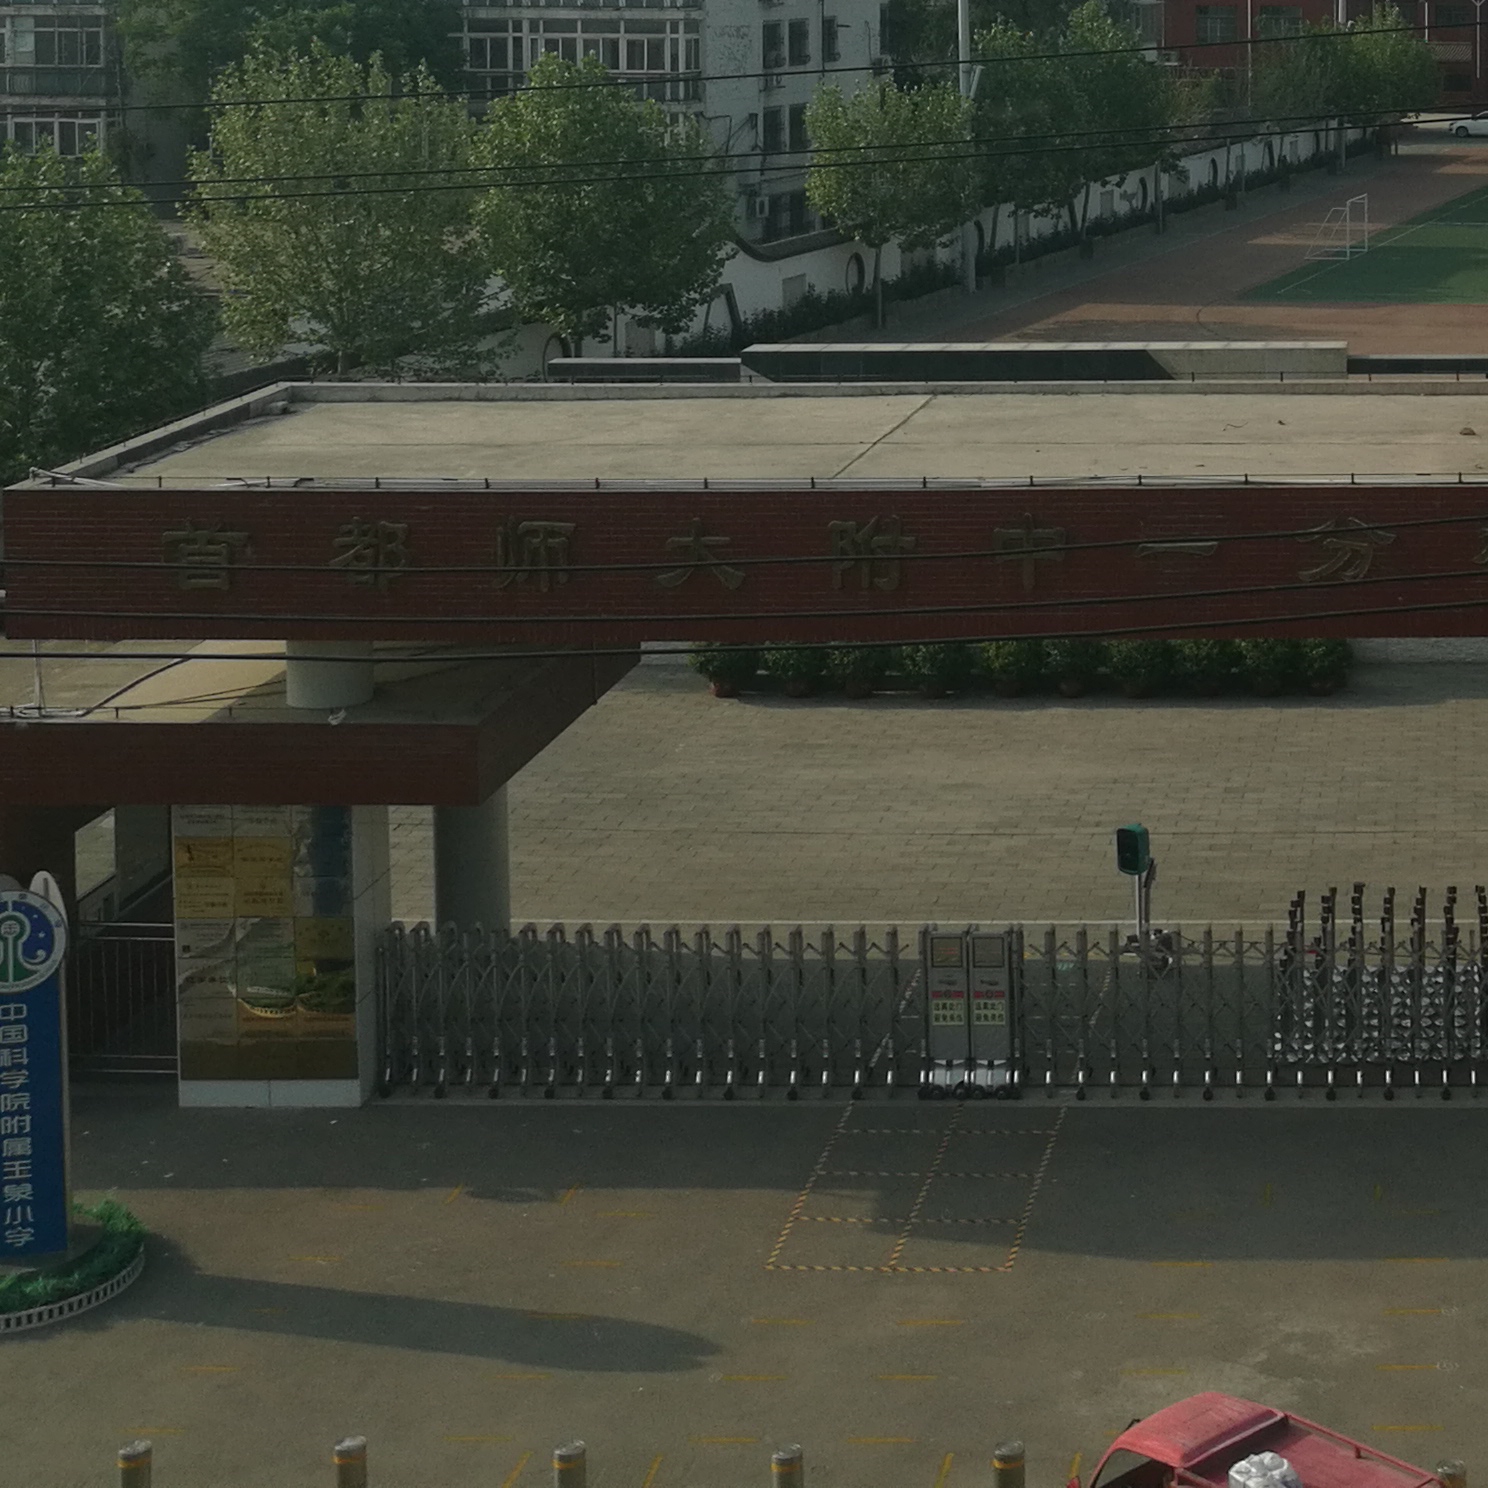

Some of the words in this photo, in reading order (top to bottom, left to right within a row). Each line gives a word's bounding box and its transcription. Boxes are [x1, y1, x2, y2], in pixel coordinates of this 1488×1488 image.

[0, 1003, 34, 1247] 中国科学院附属玉泉小学
